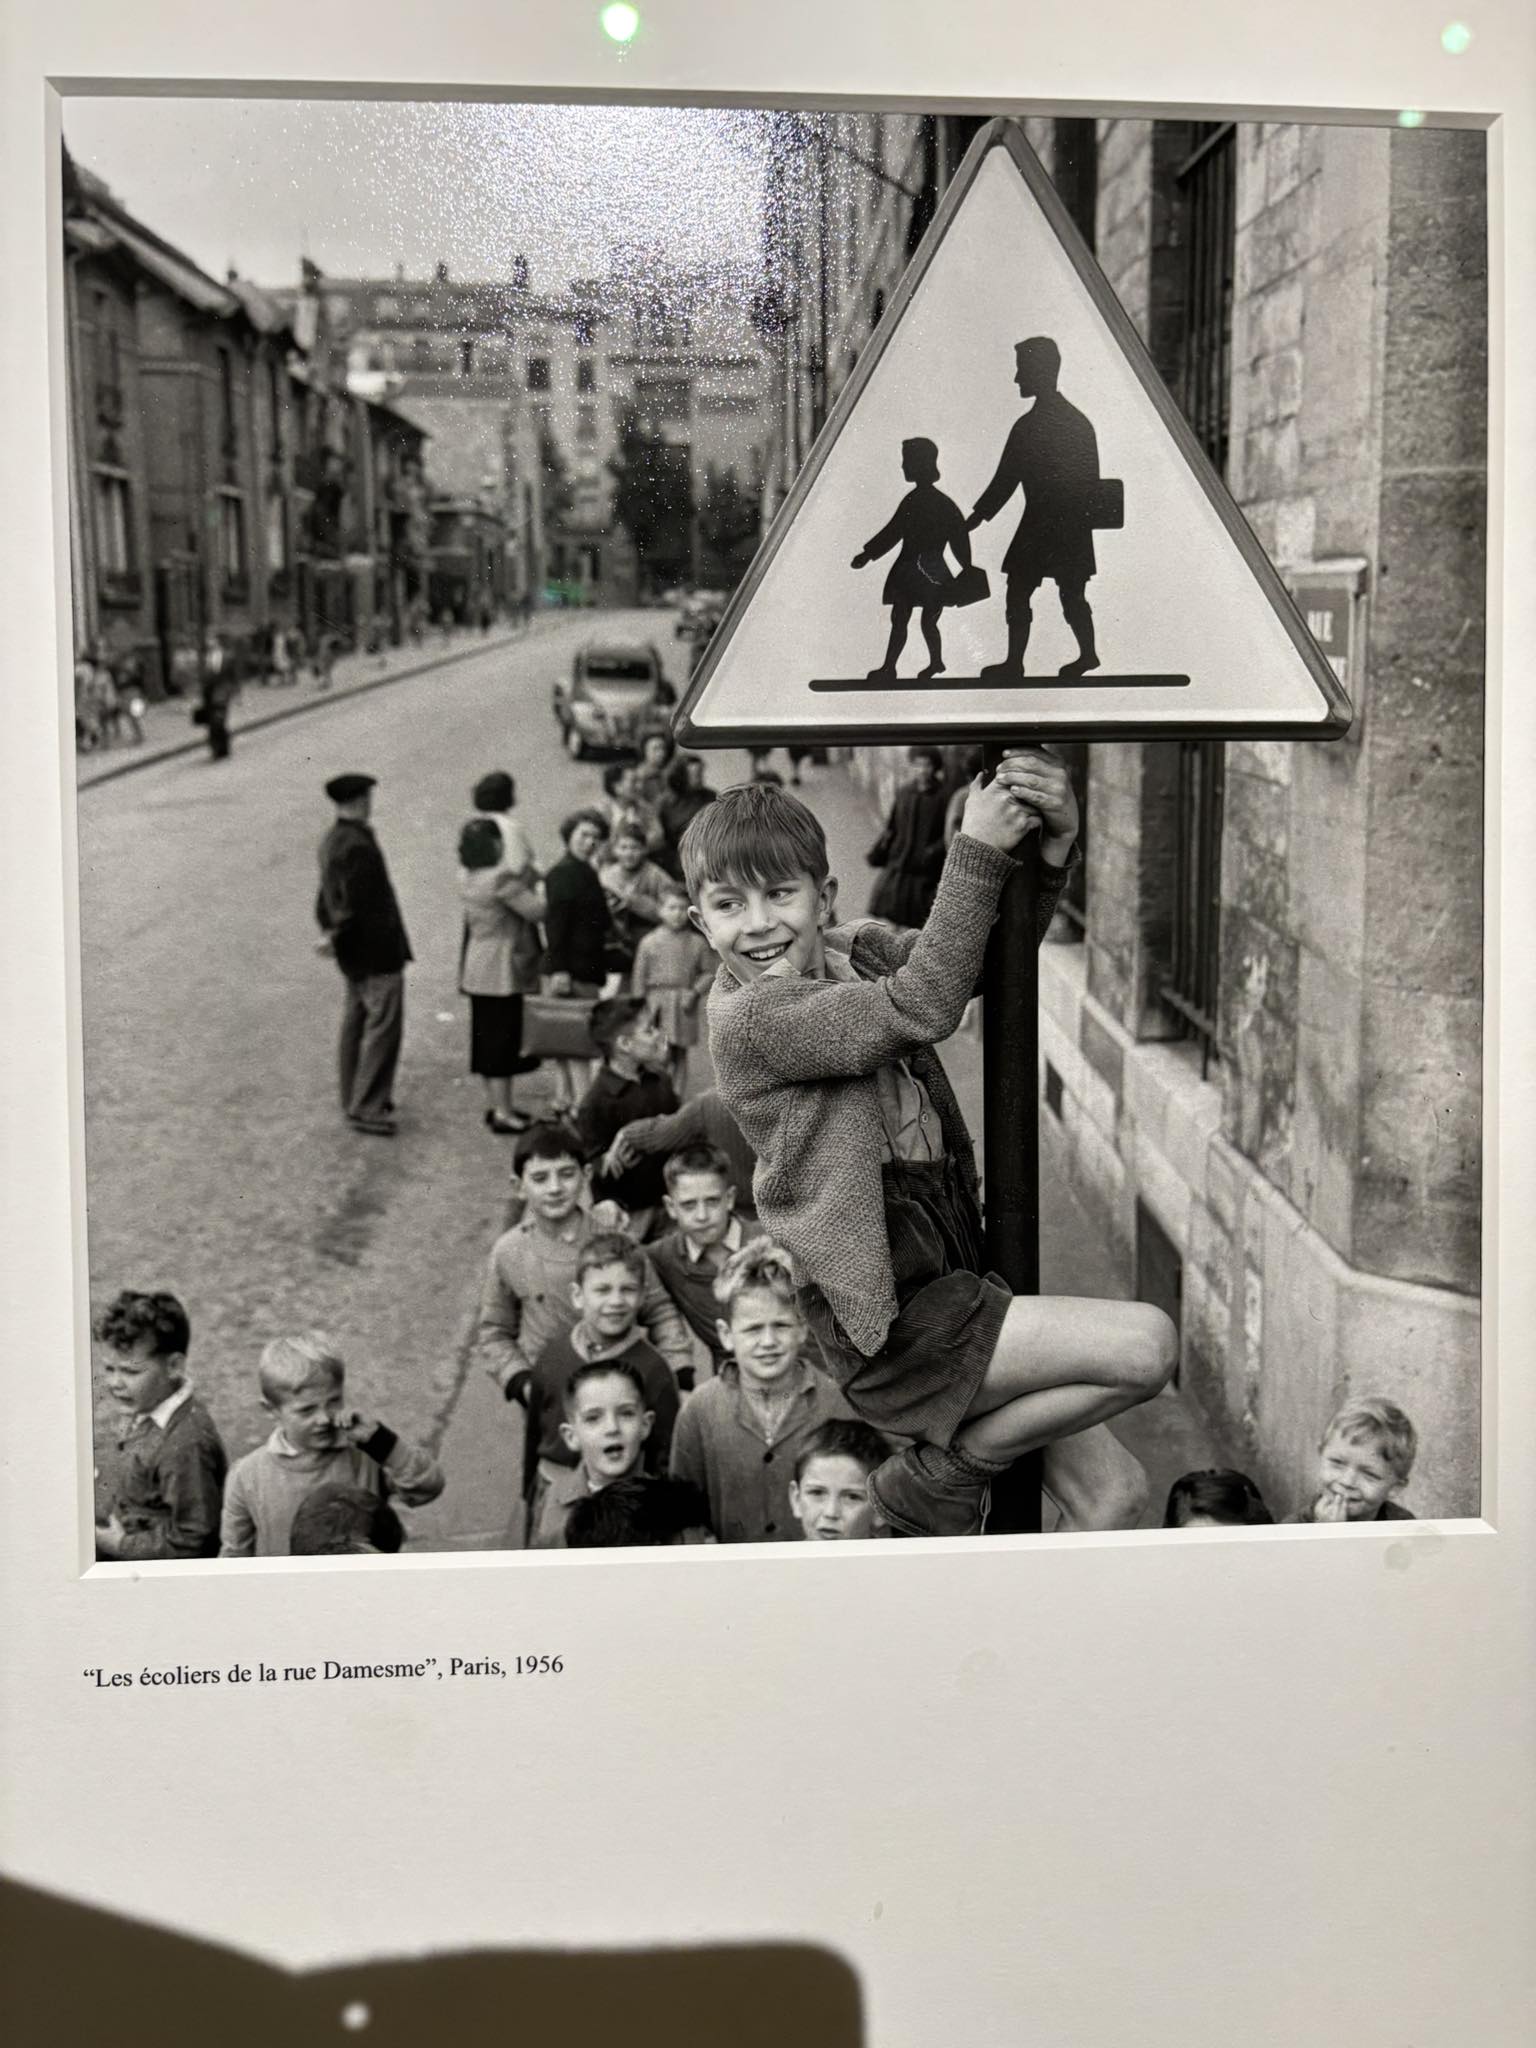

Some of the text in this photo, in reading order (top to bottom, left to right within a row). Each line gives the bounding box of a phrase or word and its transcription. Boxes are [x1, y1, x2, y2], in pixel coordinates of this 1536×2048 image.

[140, 1665, 220, 1687] écoliers
[228, 1663, 252, 1684] de
[259, 1662, 277, 1682] la
[284, 1667, 316, 1681] rue
[450, 1656, 506, 1679] Paris,
[516, 1655, 563, 1675] 1956
